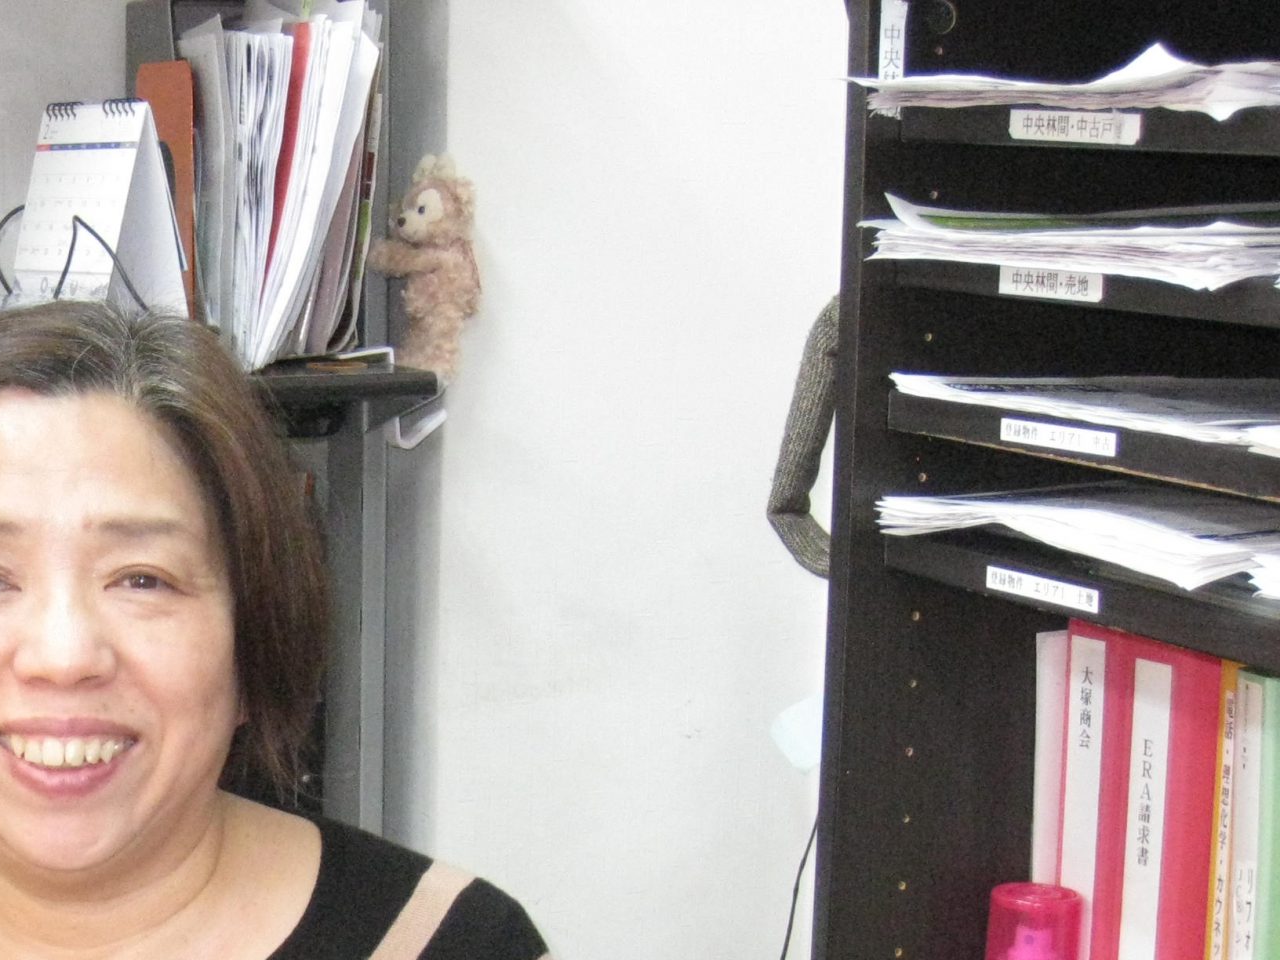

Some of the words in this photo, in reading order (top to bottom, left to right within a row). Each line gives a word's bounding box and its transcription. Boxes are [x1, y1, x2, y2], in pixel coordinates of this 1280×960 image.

[1011, 269, 1089, 296] 中央林間・売地
[1079, 666, 1094, 749] 大塚商会
